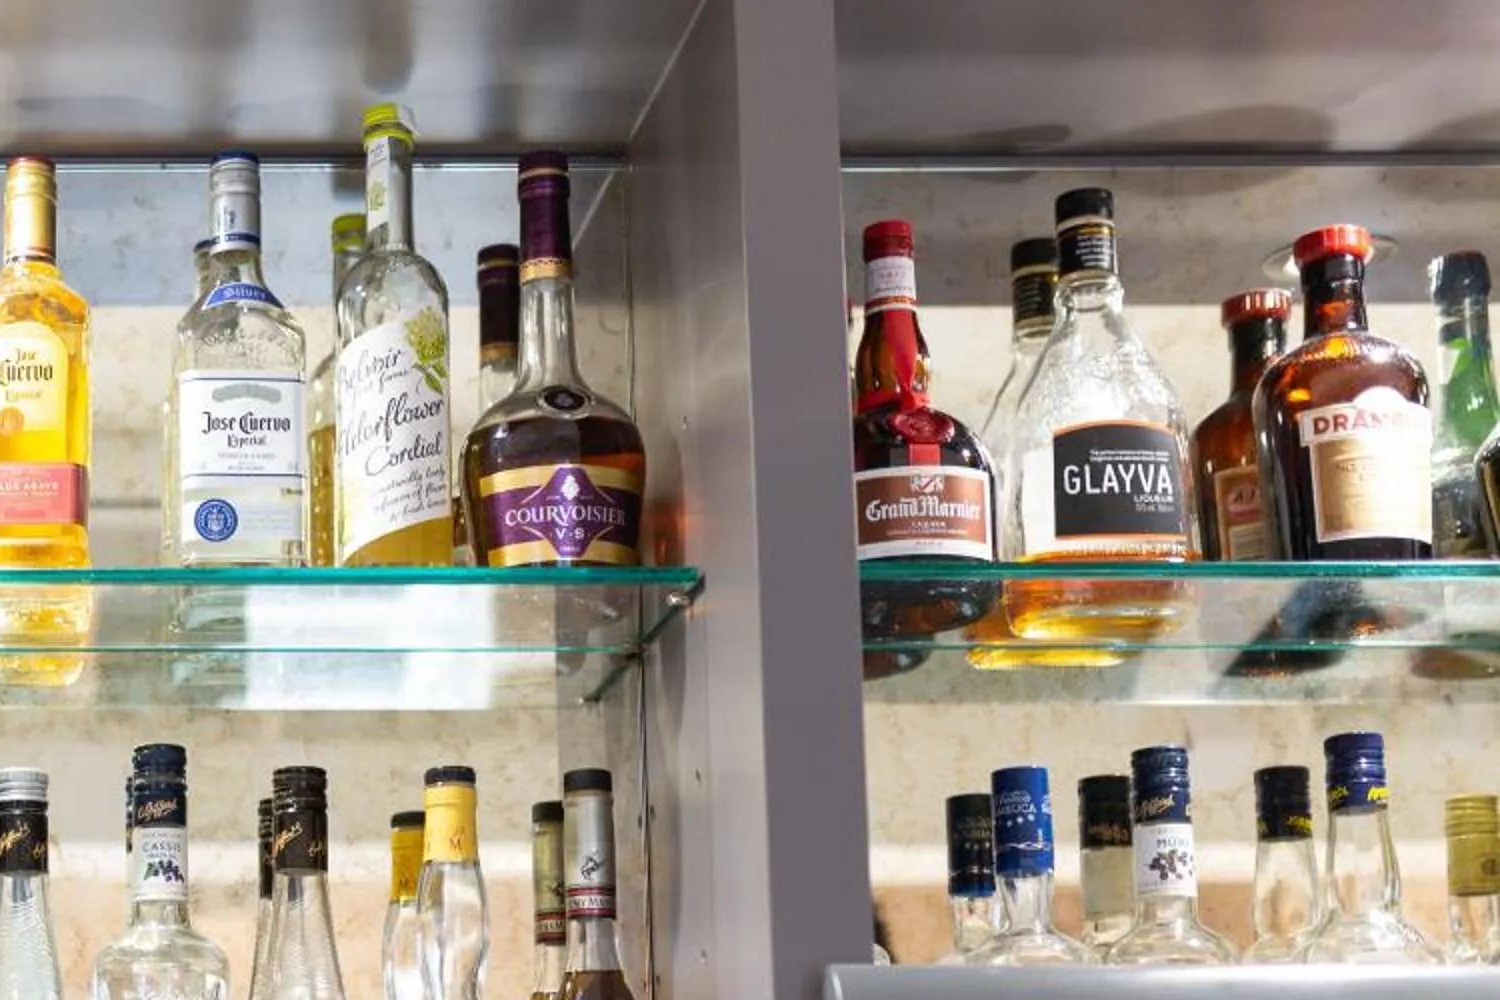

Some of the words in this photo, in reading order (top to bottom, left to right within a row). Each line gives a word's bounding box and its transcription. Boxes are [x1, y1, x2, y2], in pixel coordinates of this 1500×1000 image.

[202, 411, 236, 434] Jose
[239, 411, 290, 434] Cuervo
[1312, 408, 1408, 435] DRAM
[1063, 463, 1173, 495] GLAYVA
[505, 505, 625, 526] COURVOISIER
[866, 497, 919, 522] Grand
